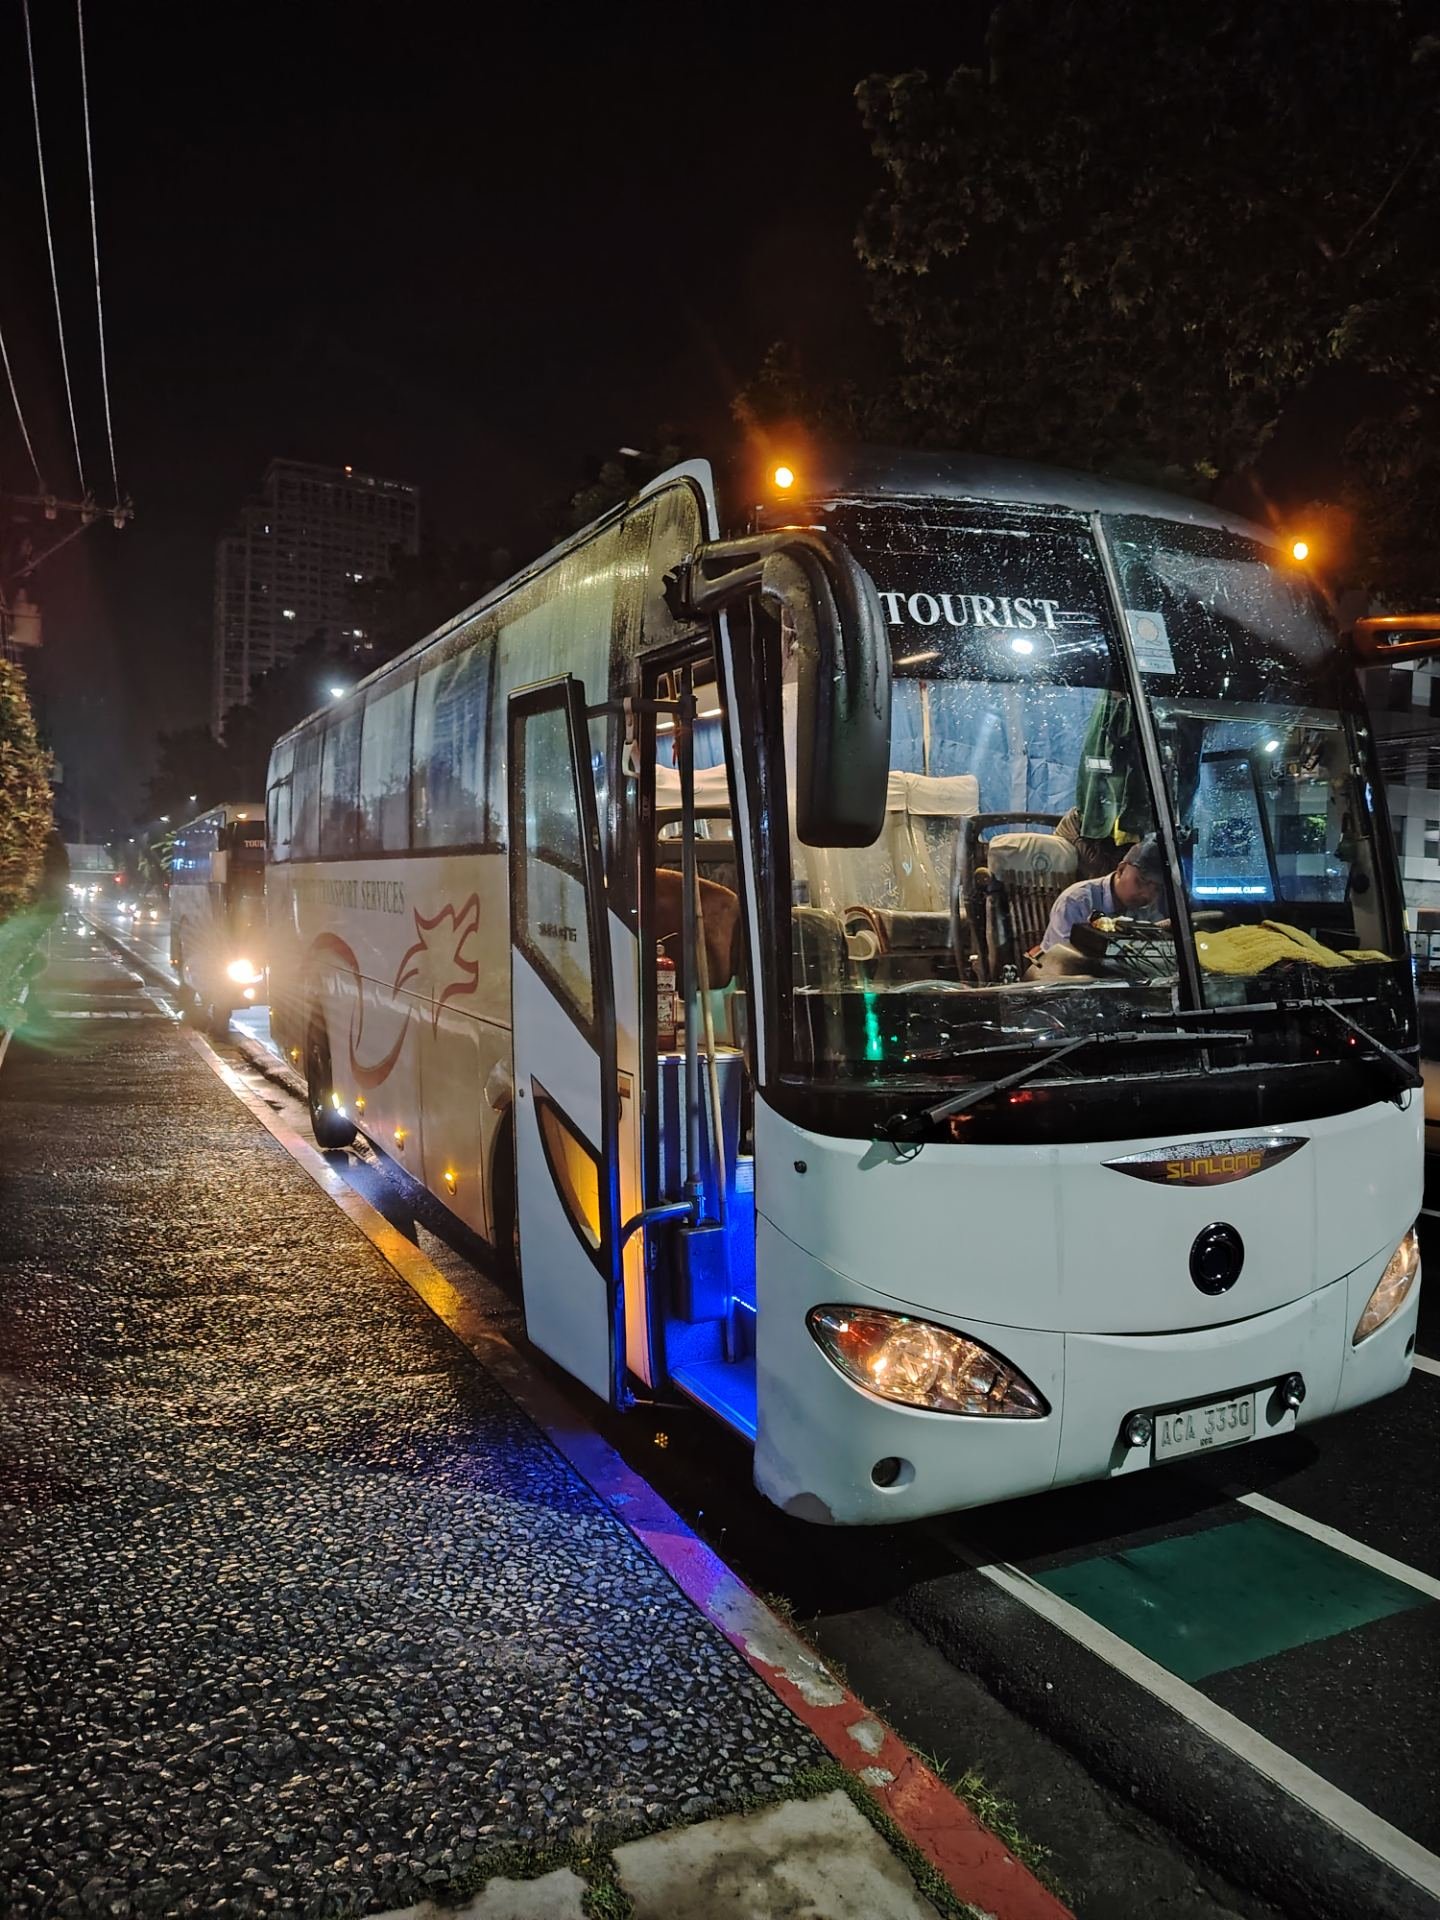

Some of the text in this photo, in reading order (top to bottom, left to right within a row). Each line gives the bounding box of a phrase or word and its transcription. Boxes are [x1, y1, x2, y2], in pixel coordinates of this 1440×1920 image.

[878, 592, 1060, 630] TOURIST
[361, 880, 405, 914] SERVICES
[1166, 1153, 1262, 1179] SUNLONG
